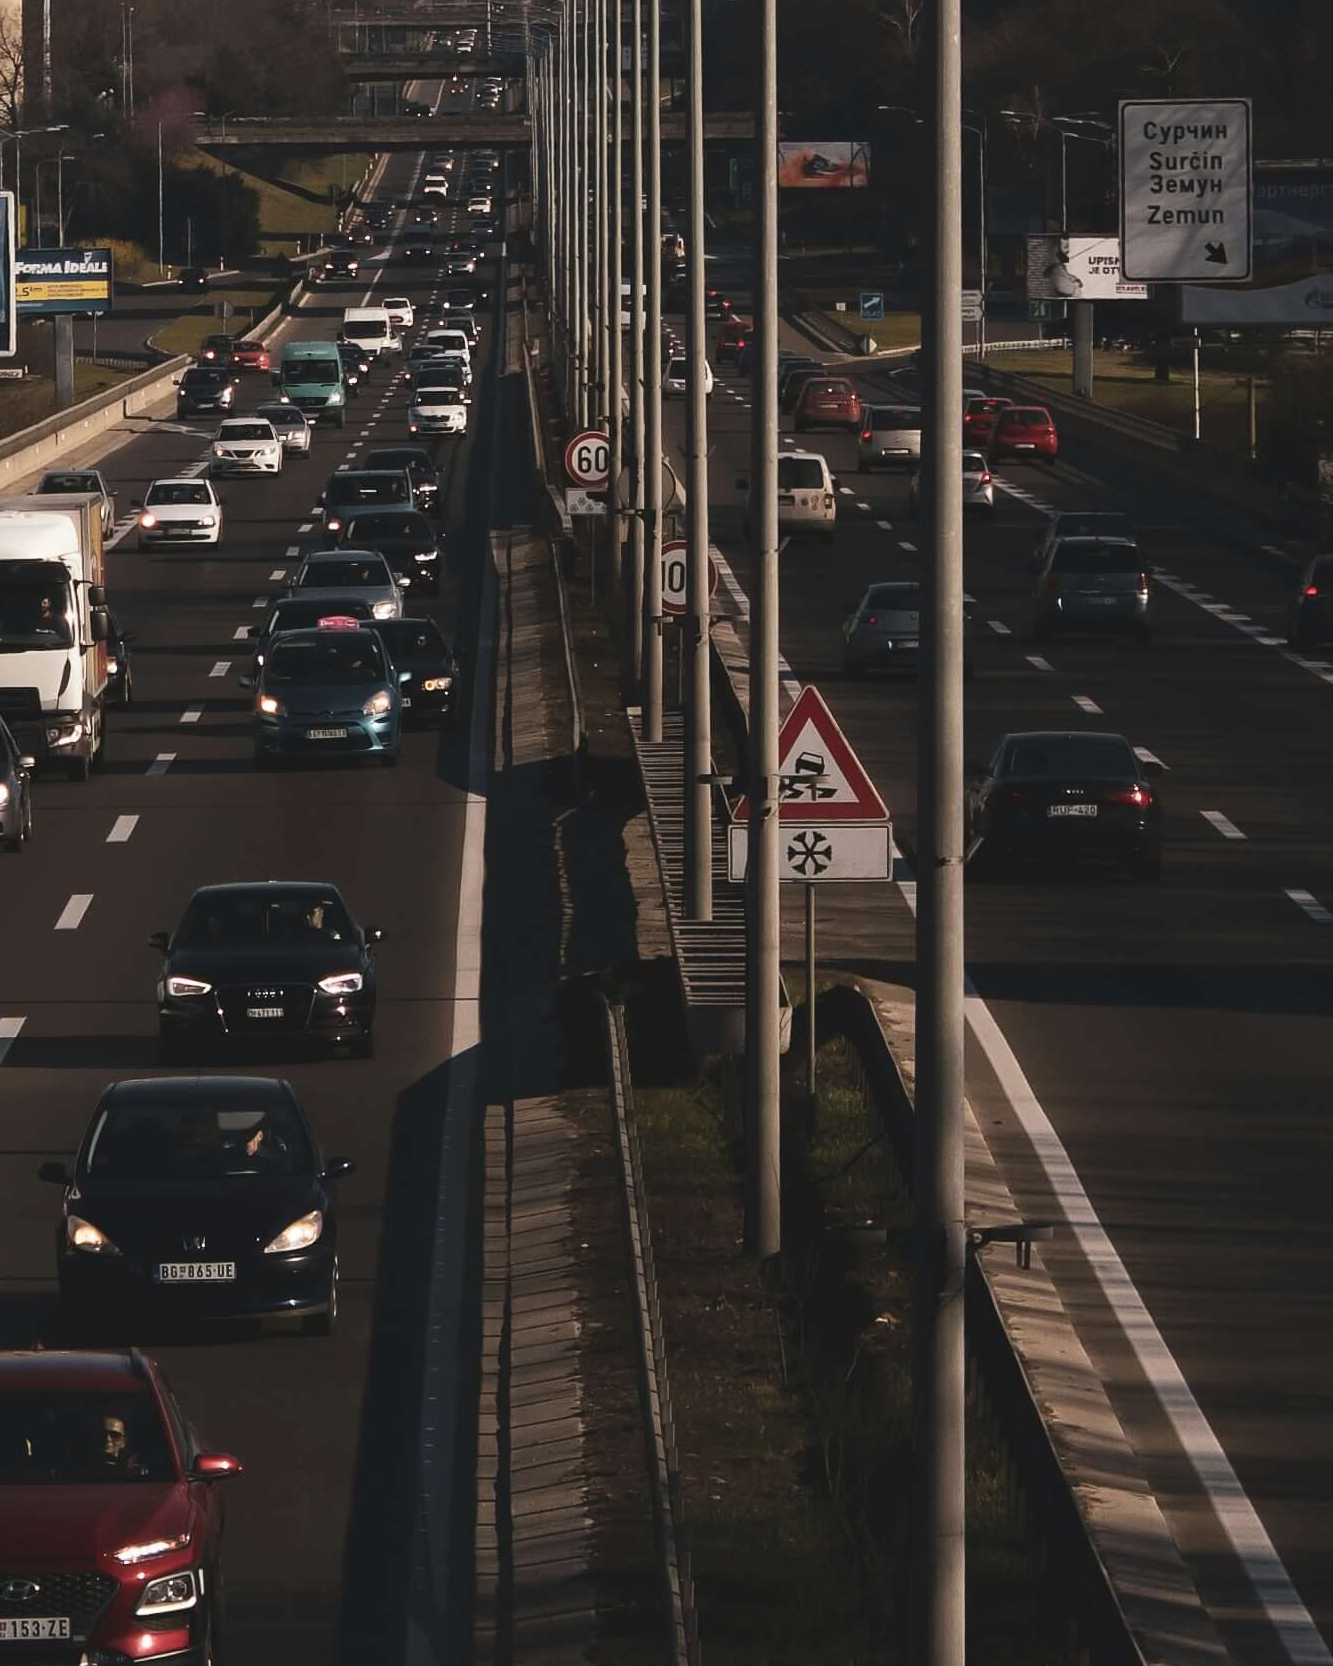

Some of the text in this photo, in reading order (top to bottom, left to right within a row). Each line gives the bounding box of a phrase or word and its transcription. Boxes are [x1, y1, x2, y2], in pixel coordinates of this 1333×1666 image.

[1143, 121, 1228, 145] Сурчин
[1148, 150, 1223, 171] Surčin
[1149, 174, 1223, 198] Земун
[1147, 204, 1224, 225] Zemun
[577, 445, 609, 474] 60
[162, 1265, 177, 1279] BG
